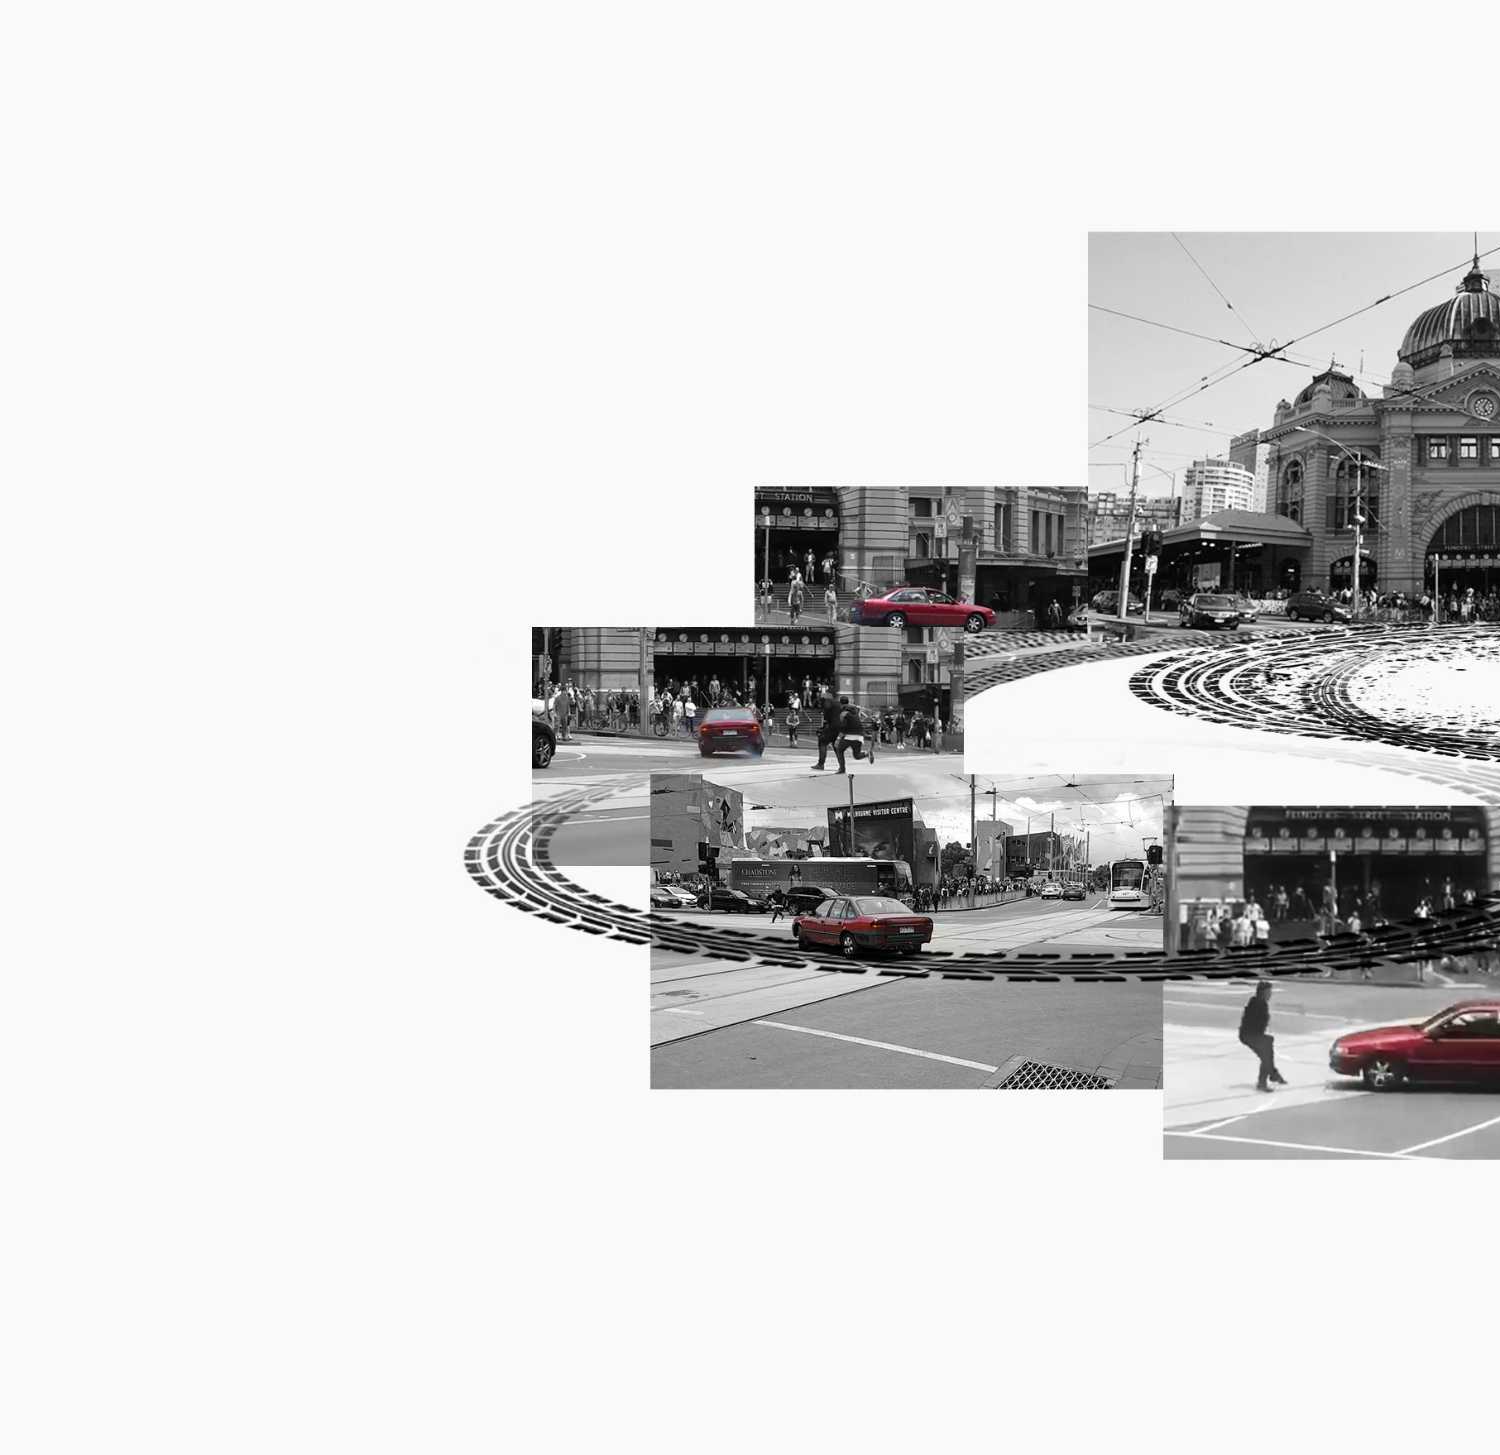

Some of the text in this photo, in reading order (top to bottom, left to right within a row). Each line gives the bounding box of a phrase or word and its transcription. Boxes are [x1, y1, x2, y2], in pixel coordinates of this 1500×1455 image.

[775, 493, 814, 502] STATION
[846, 809, 871, 817] MLBOURNE
[873, 808, 890, 816] VISITOR
[890, 806, 908, 815] CENTRE
[1405, 811, 1450, 821] STATION
